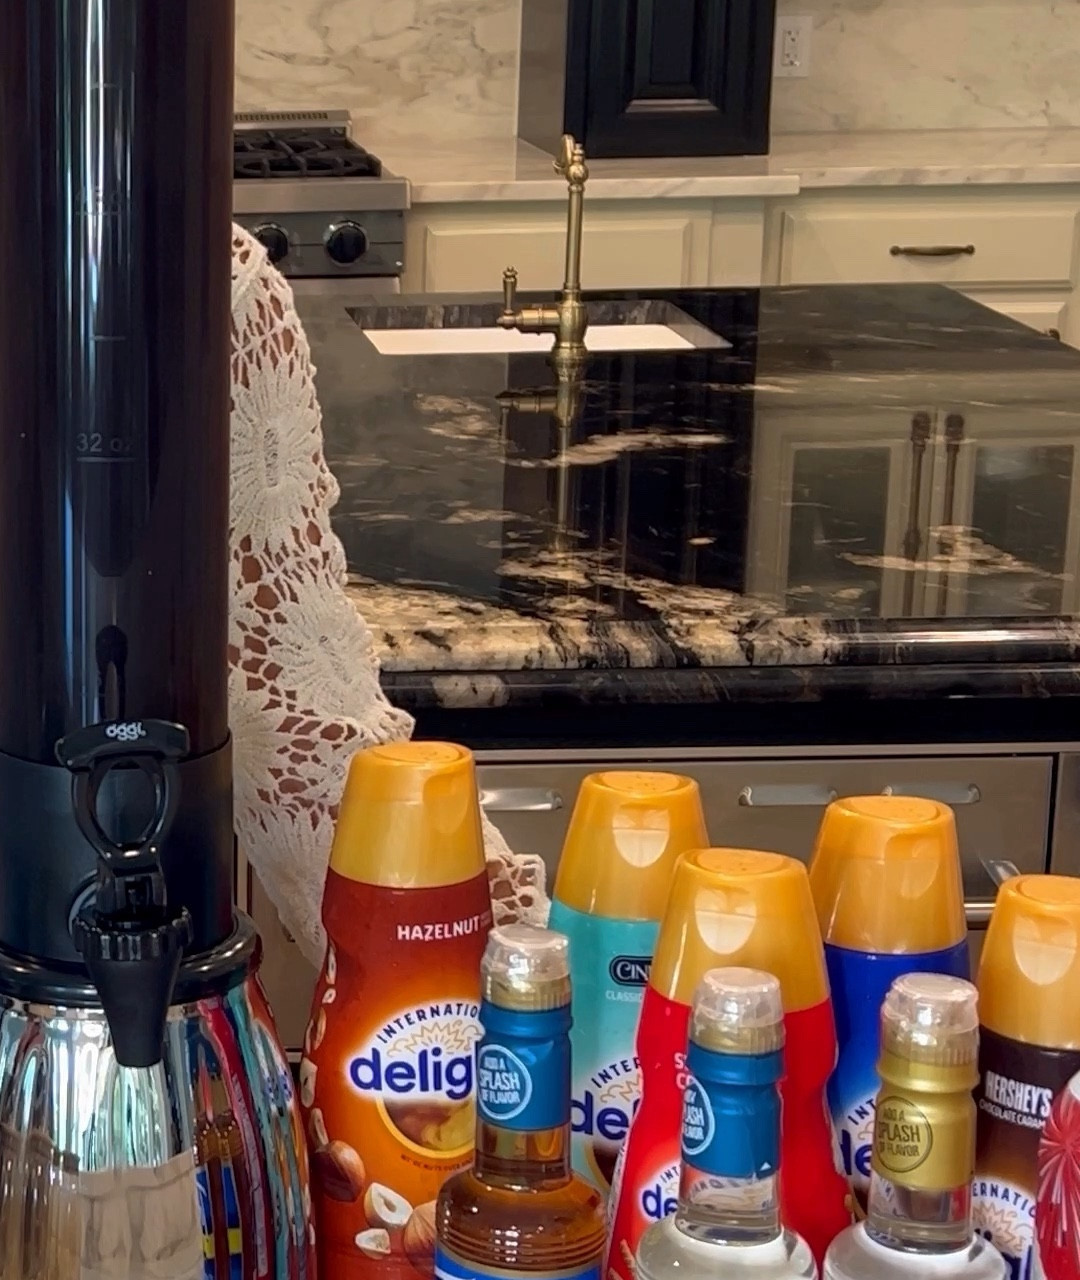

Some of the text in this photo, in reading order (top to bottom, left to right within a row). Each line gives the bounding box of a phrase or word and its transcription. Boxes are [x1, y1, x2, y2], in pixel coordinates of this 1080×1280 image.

[76, 432, 102, 453] 32
[397, 915, 479, 941] HAZELNUT
[616, 961, 652, 981] CIN
[376, 1003, 478, 1044] INTERNATIO
[350, 1047, 473, 1100] delig
[480, 1069, 521, 1090] SPLASH
[986, 1070, 1053, 1118] HERSHEY'S
[878, 1121, 921, 1143] SPLASH
[887, 1142, 920, 1157] FLAVOR
